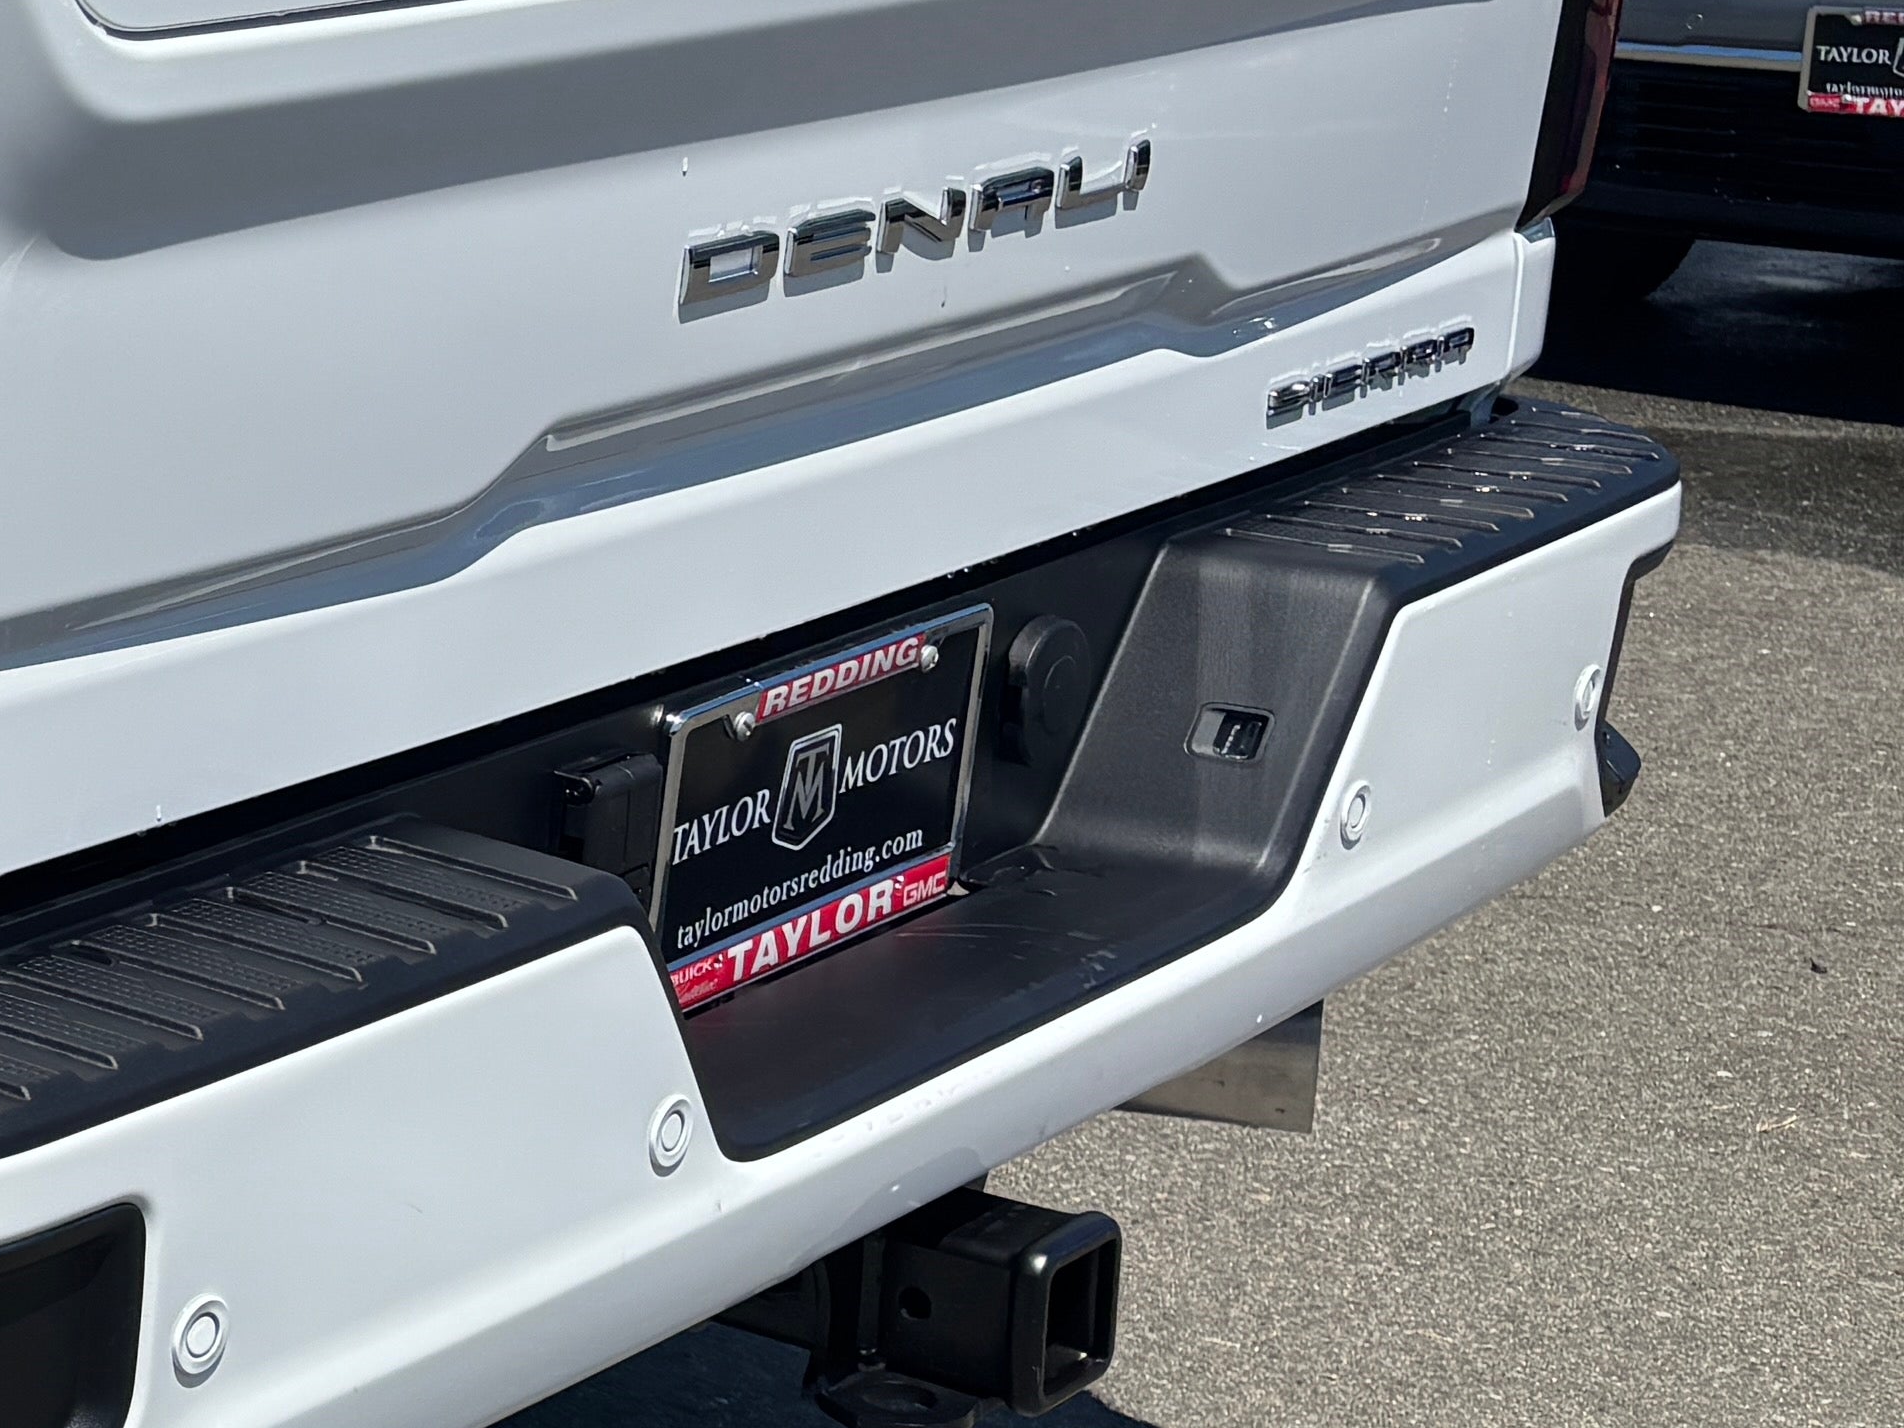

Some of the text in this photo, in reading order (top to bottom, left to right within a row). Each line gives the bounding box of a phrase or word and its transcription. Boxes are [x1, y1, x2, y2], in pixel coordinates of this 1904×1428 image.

[1816, 45, 1891, 66] TAYLOR
[678, 139, 1151, 305] DENALI
[1267, 327, 1475, 415] SIERRA
[762, 637, 919, 717] REDDING
[672, 718, 957, 865] TAYLOR MOTORS
[670, 871, 947, 986] BUICK TAYLOR GMC
[677, 828, 924, 949] taylormotorsredding.com
